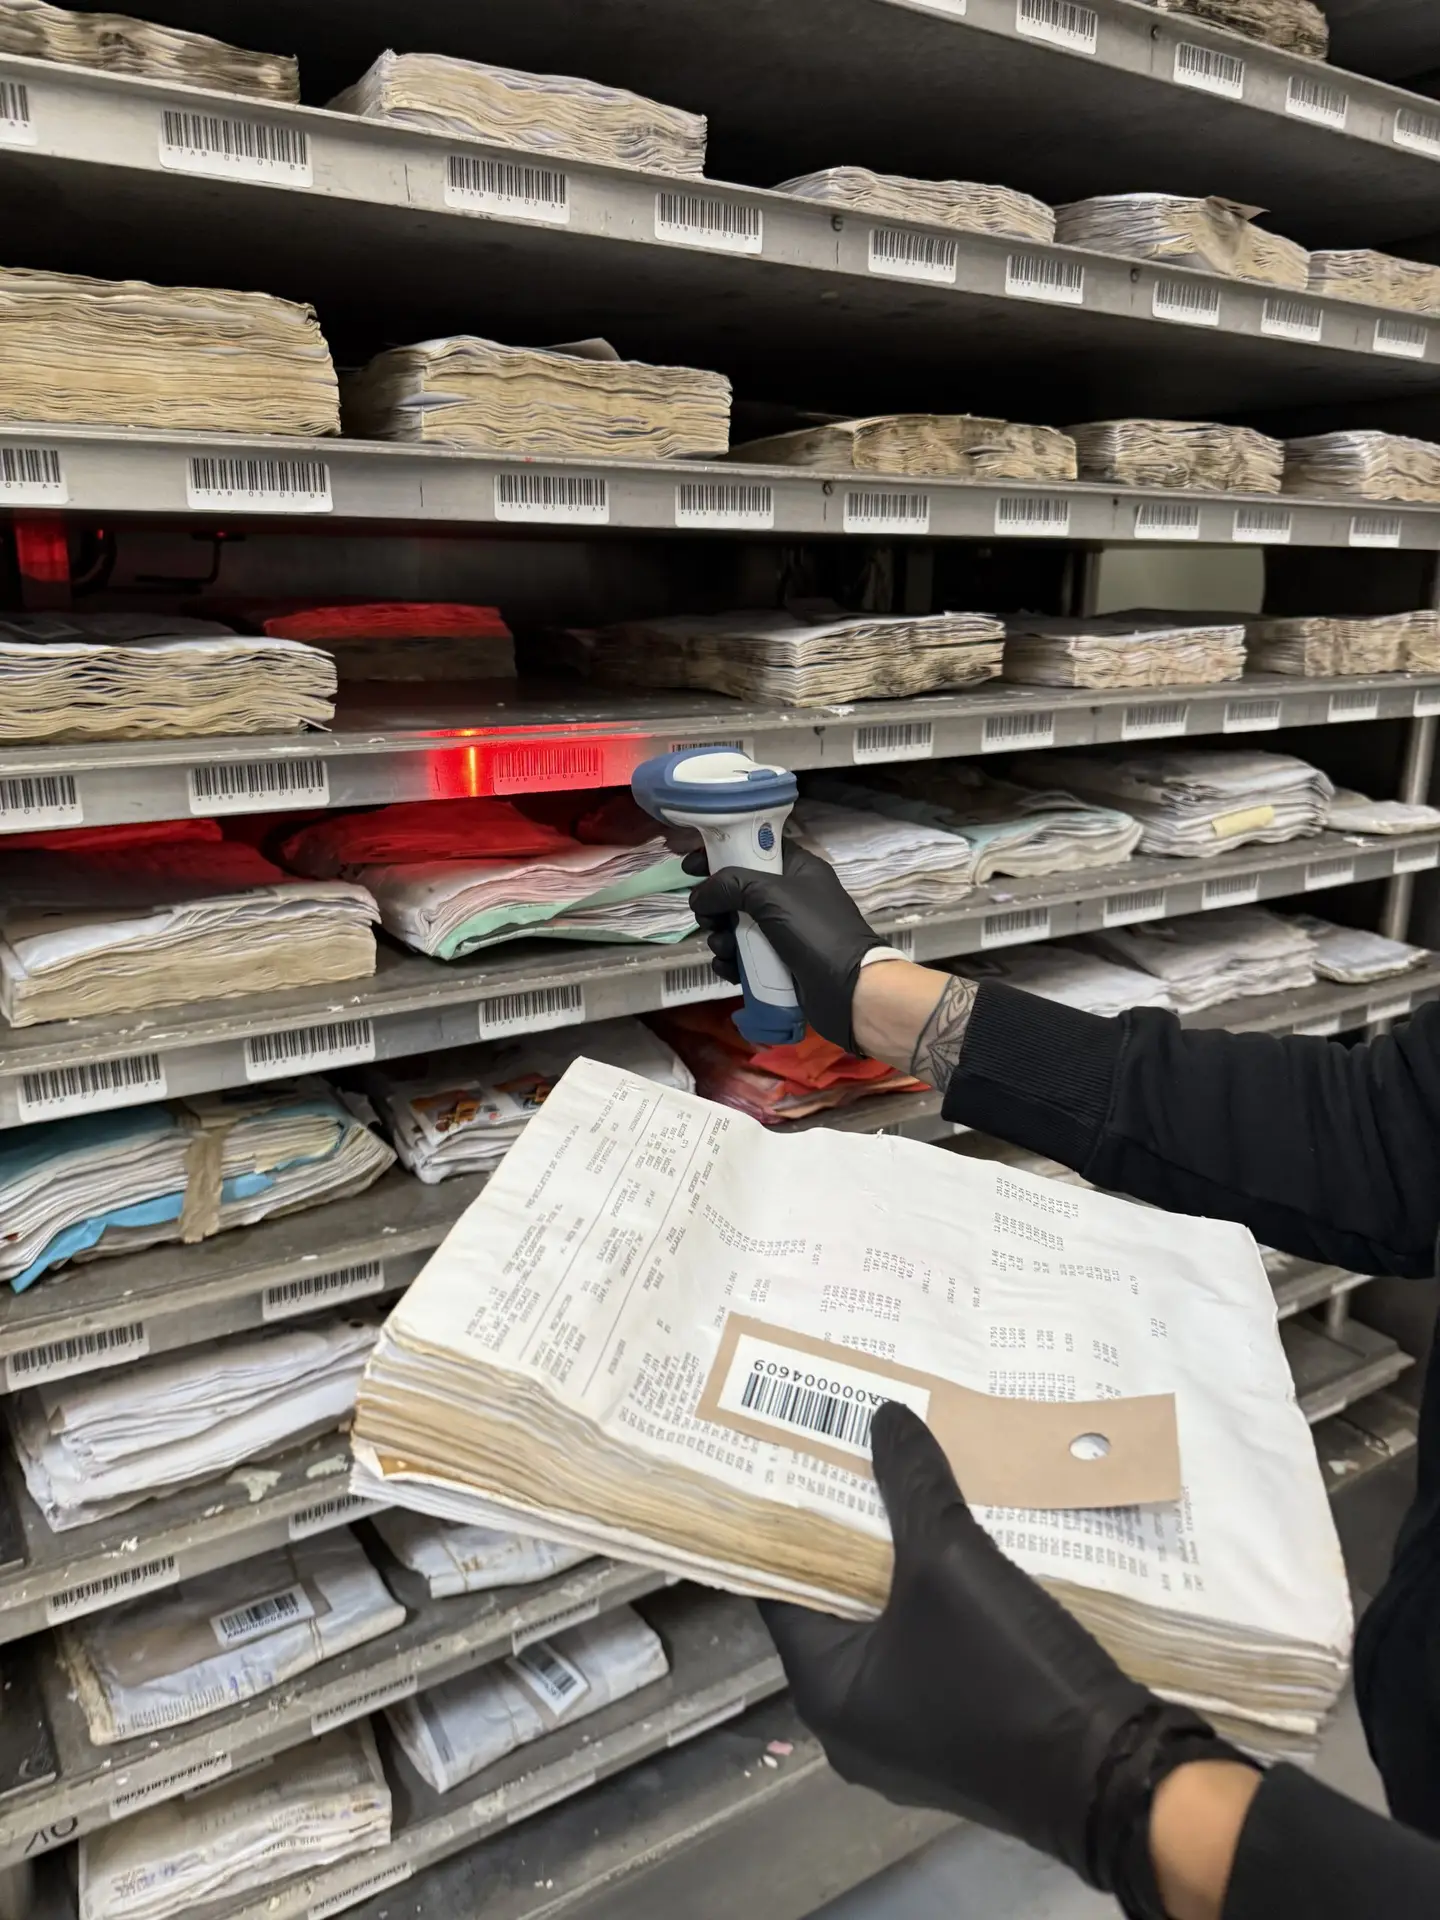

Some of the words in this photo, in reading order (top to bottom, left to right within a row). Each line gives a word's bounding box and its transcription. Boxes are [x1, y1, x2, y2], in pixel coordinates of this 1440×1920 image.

[224, 153, 242, 162] 04
[257, 158, 275, 168] 01
[497, 194, 511, 202] 04
